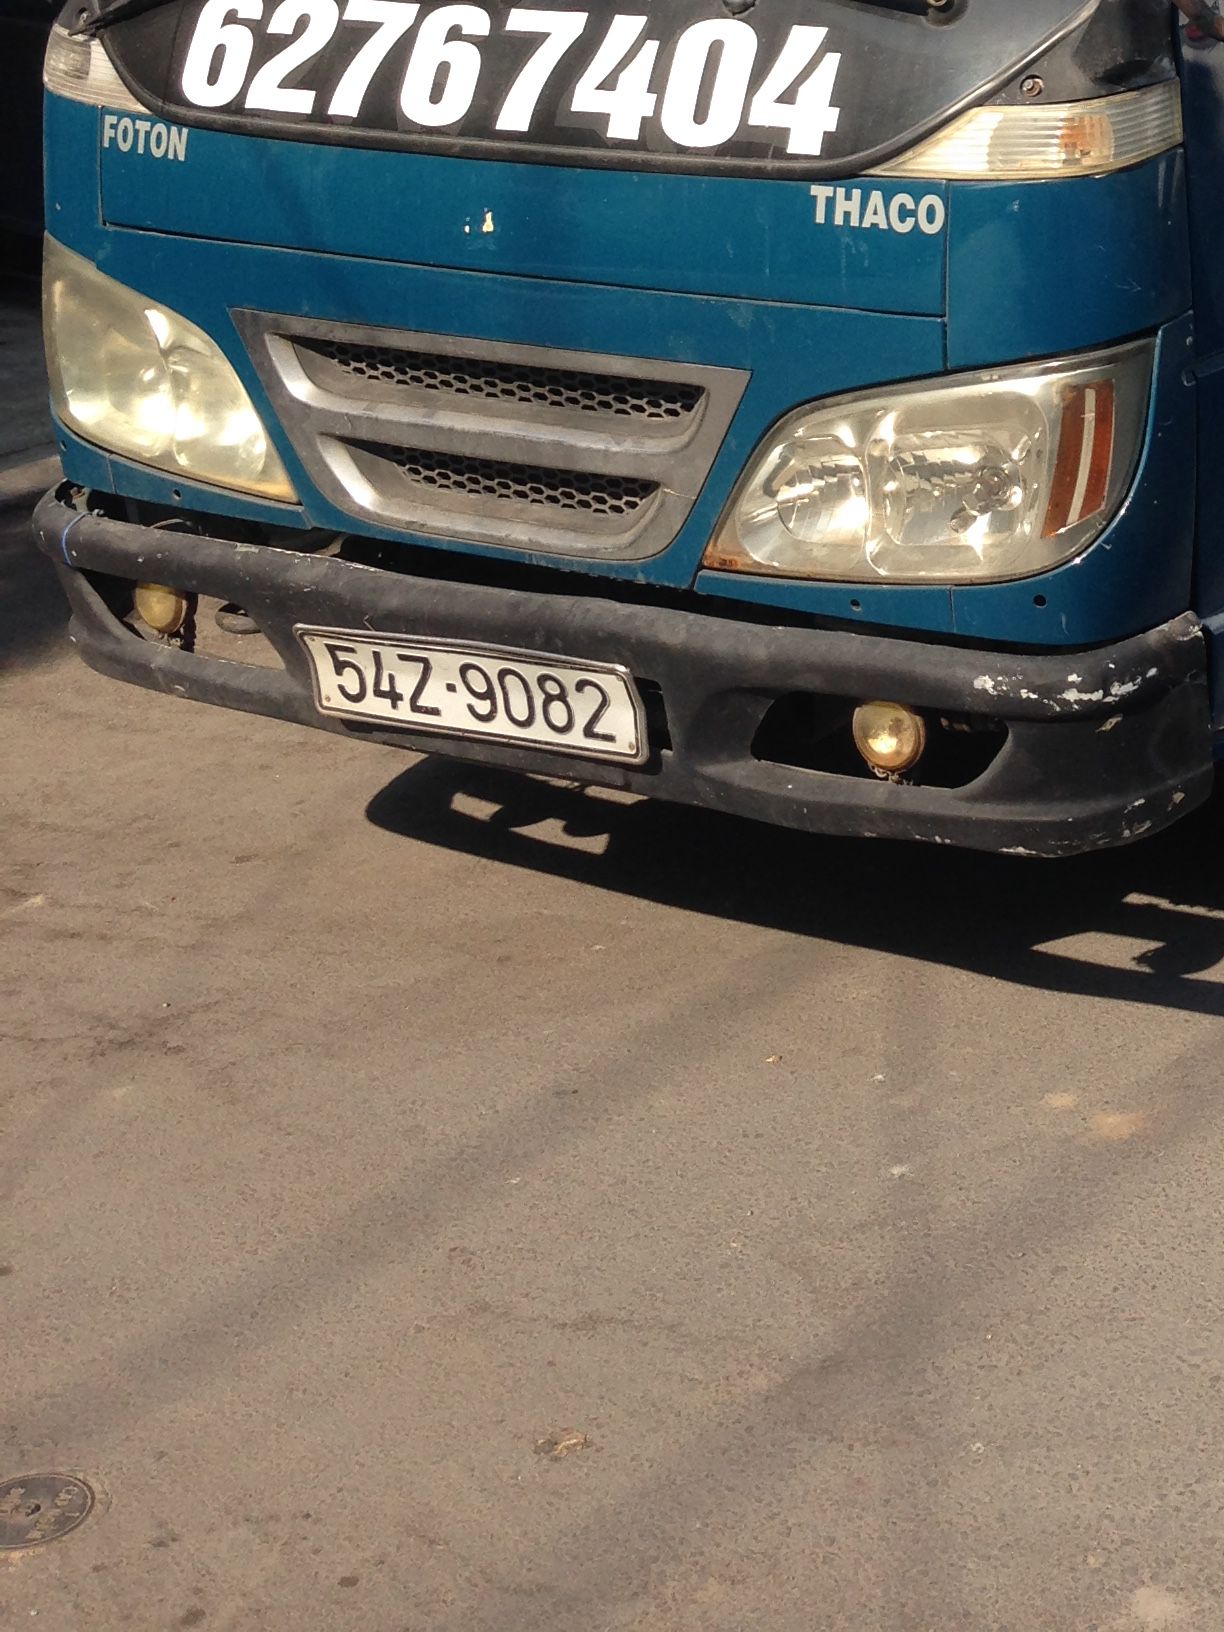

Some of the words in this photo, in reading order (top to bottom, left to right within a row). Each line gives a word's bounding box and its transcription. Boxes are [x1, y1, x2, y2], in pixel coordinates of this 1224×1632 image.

[103, 115, 189, 162] FOTON
[810, 184, 945, 235] THACO
[324, 642, 617, 743] 54Z-9082
